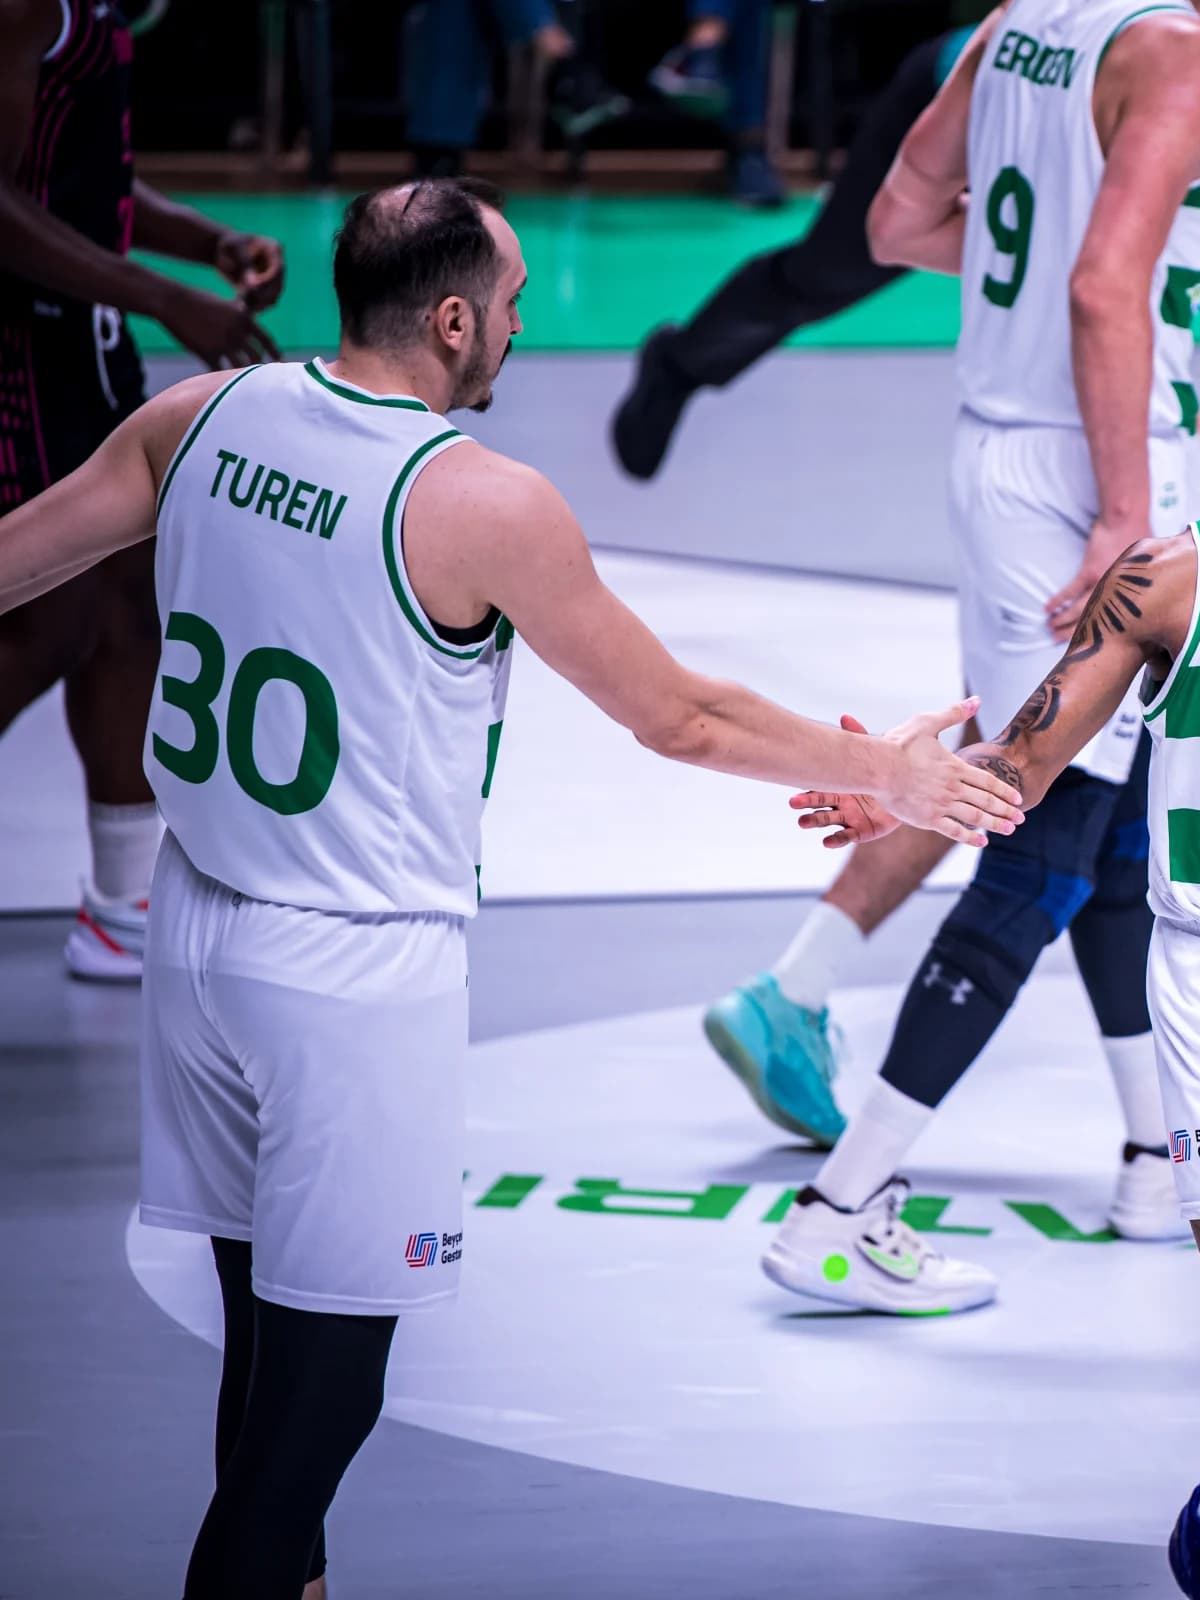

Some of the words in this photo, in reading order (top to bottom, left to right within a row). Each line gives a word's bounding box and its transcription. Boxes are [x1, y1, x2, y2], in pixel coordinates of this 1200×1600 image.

[982, 165, 1035, 309] 9
[209, 449, 348, 540] TUREN
[152, 611, 341, 816] 30
